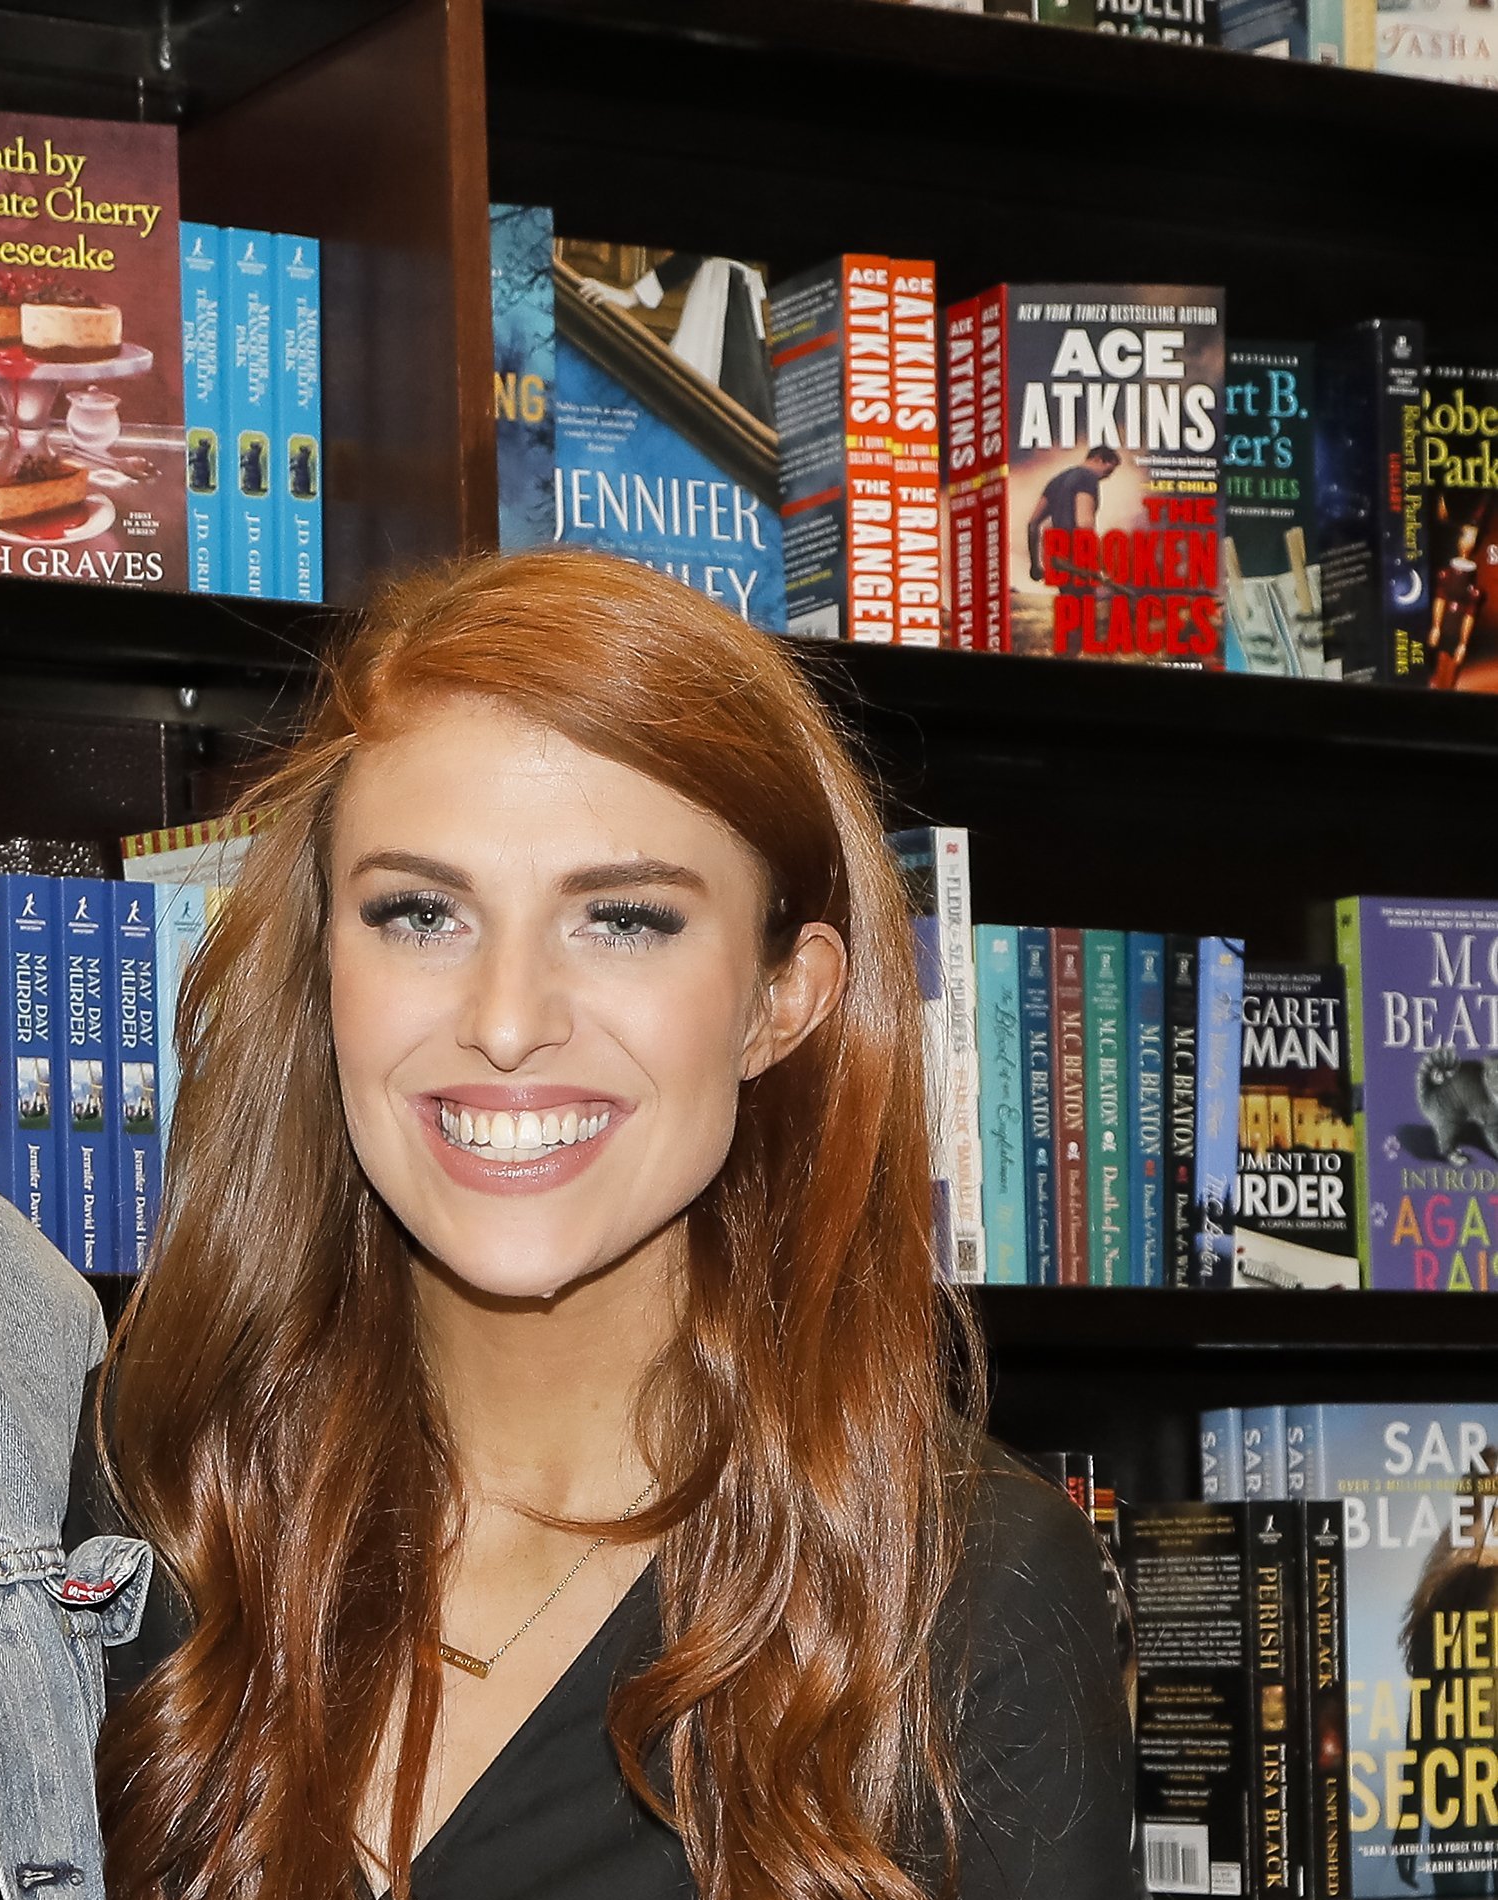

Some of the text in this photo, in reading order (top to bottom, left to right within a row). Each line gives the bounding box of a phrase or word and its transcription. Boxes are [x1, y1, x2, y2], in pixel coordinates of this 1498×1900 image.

[45, 140, 86, 188] by
[45, 187, 162, 239] Cherry
[849, 268, 888, 285] ACE
[894, 277, 933, 294] ACE
[1017, 303, 1218, 326] NEW YORK TIMES BESTSELLING AUTHOR
[849, 286, 891, 424] ATKINS
[893, 295, 937, 432] ATKINS
[981, 326, 1002, 458] ATKINS
[1051, 328, 1185, 379] ACE
[949, 340, 976, 470] ATKINS
[1019, 382, 1216, 452] ATKINS
[554, 467, 767, 550] JENNIFER
[852, 479, 890, 495] THE
[898, 487, 936, 503] THE
[1142, 498, 1218, 526] THE
[1177, 481, 1218, 493] CHILD
[22, 547, 164, 583] GRAVES
[852, 499, 894, 644] RANGER
[1043, 527, 1220, 591] BROKEN
[1053, 594, 1220, 656] PLACES
[15, 951, 33, 1044] MURDER
[33, 954, 49, 1042] MAY DAY
[69, 954, 86, 1046] MURDER
[87, 958, 102, 1044] MAY DAY
[121, 958, 138, 1049] MURDER
[139, 961, 154, 1047] MAY DAY
[1030, 1070, 1051, 1140] BEATON
[1063, 1054, 1084, 1132] BEATON
[1099, 1057, 1119, 1128] BEATON
[1139, 1071, 1161, 1157] BEATON
[1173, 1074, 1195, 1158] BEATON
[1312, 1153, 1341, 1174] TO
[1257, 1566, 1280, 1671] PERISH
[1314, 1557, 1333, 1689] LISA BLACK
[1262, 1743, 1283, 1888] LISA BLACK
[1325, 1776, 1340, 1897] UNPUNISHED
